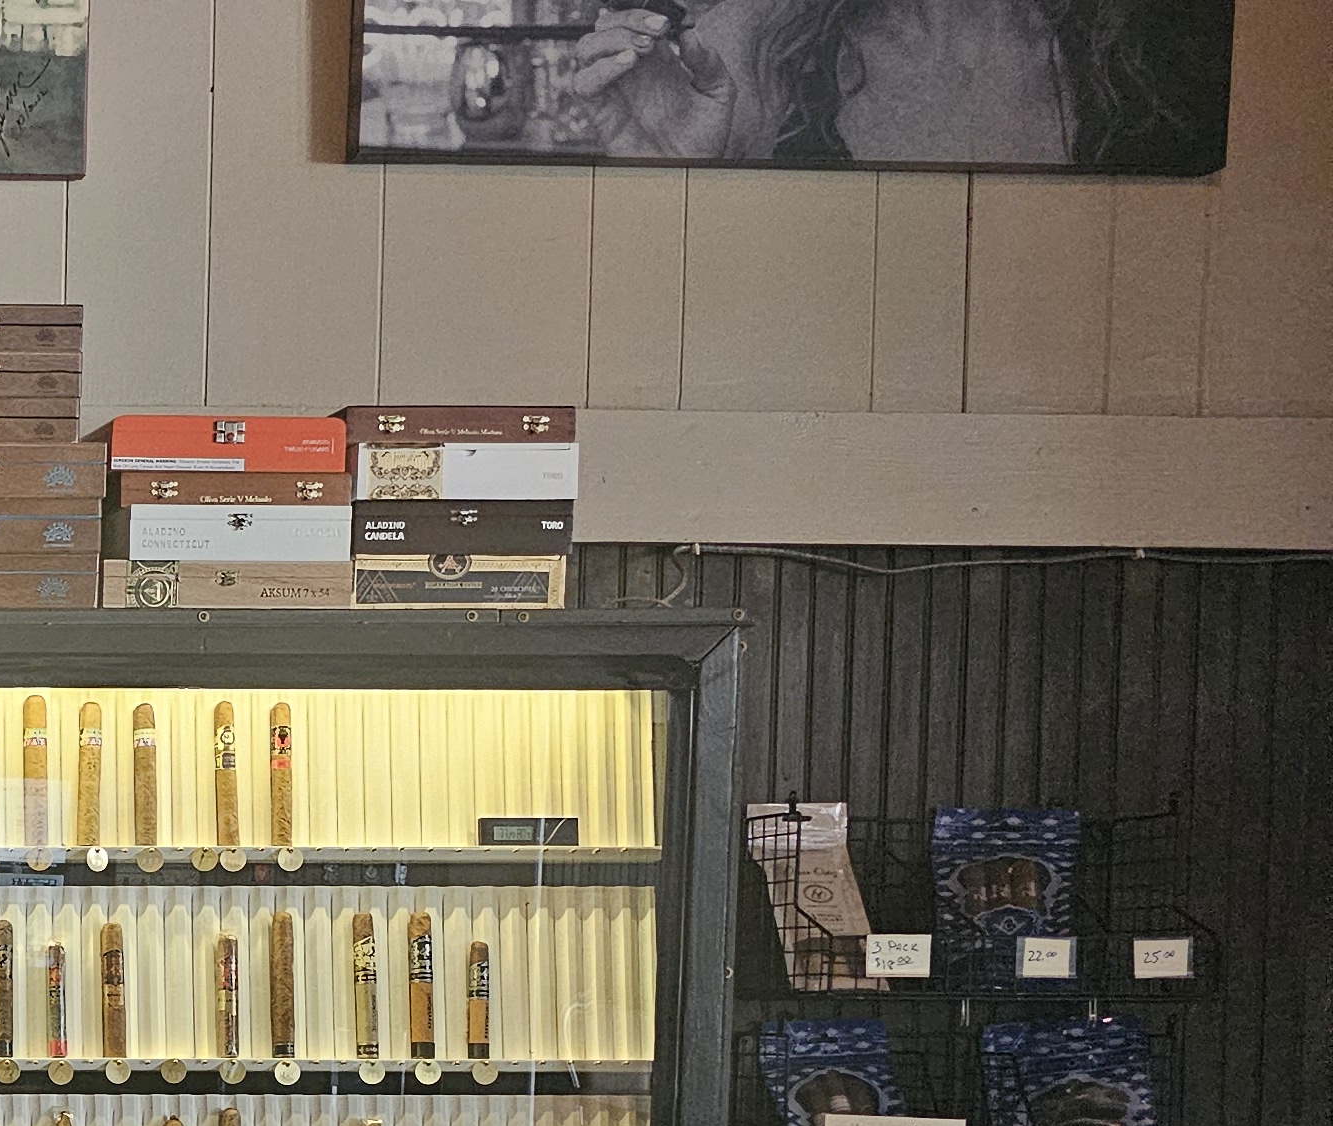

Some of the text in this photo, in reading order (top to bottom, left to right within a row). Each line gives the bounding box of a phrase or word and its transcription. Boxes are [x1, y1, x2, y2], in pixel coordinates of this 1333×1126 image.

[365, 521, 405, 530] ALADINO
[541, 521, 564, 530] TORO
[365, 532, 405, 541] CANDELA
[260, 588, 301, 598] AKSUM
[303, 588, 308, 598] 7
[318, 588, 329, 598] 54
[873, 940, 919, 953] 3 PACK
